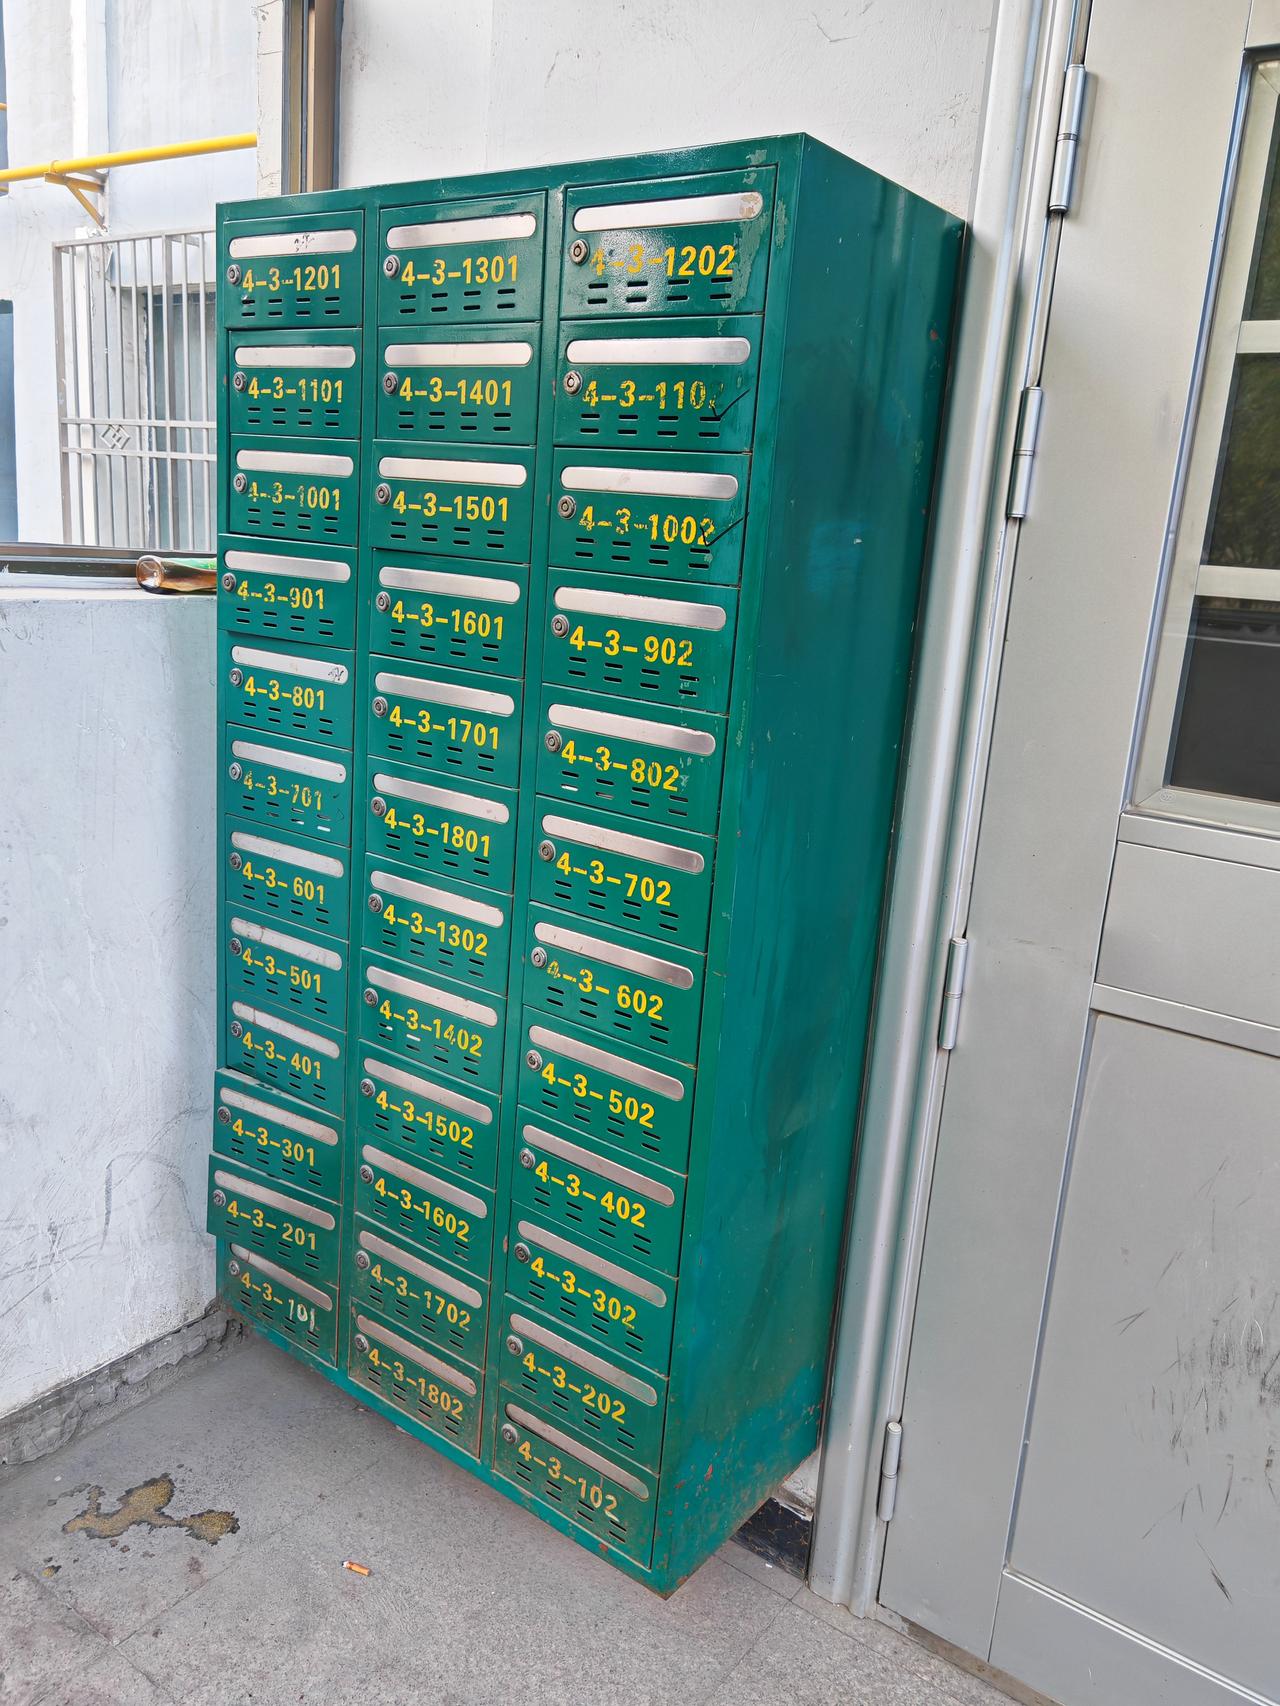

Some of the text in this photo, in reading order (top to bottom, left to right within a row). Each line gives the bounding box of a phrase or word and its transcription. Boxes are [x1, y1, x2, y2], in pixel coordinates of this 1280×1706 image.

[242, 264, 341, 293] 4-3-1201
[400, 254, 518, 287] 4-3-1301
[590, 243, 736, 278] 4-3-1202
[248, 377, 343, 404] 4-3-1101
[399, 376, 512, 406] 4-3-1401
[583, 379, 724, 410] 4-3-110
[393, 490, 508, 522] 4-3-1501
[579, 505, 715, 546] 4-3-1002
[236, 580, 324, 609] 4-3-901
[391, 600, 504, 641] 4-3-1601
[569, 625, 693, 667] 4-3-902
[244, 676, 325, 711] 4-3-801
[389, 705, 499, 750] 4-3-1701
[243, 771, 322, 810] 4-3-701
[561, 740, 680, 792] 4-3-802
[384, 808, 490, 858] 4-3-1801
[242, 861, 325, 904] 4-3-601
[556, 852, 672, 907] 4-3-702
[383, 904, 488, 957] 4-3-1302
[242, 948, 322, 994] 4-3-501
[547, 960, 664, 1020] 4-3-602
[379, 1000, 483, 1057] 4-3-1402
[242, 1031, 321, 1080] 4-3-401
[376, 1090, 474, 1149] 4-3-1502
[541, 1062, 655, 1129] 4-3-502
[232, 1118, 315, 1167] 4-3-301
[375, 1178, 470, 1242] 4-3-1602
[535, 1160, 646, 1229] 4-3-402
[227, 1200, 317, 1250] 4-3-201
[241, 1272, 316, 1332] 4-3-101
[370, 1263, 471, 1331] 4-3-1702
[530, 1256, 637, 1329] 4-3-302
[368, 1348, 464, 1421] 4-3-1802
[522, 1351, 626, 1424] 4-3-202
[517, 1440, 618, 1522] 4-3-102
